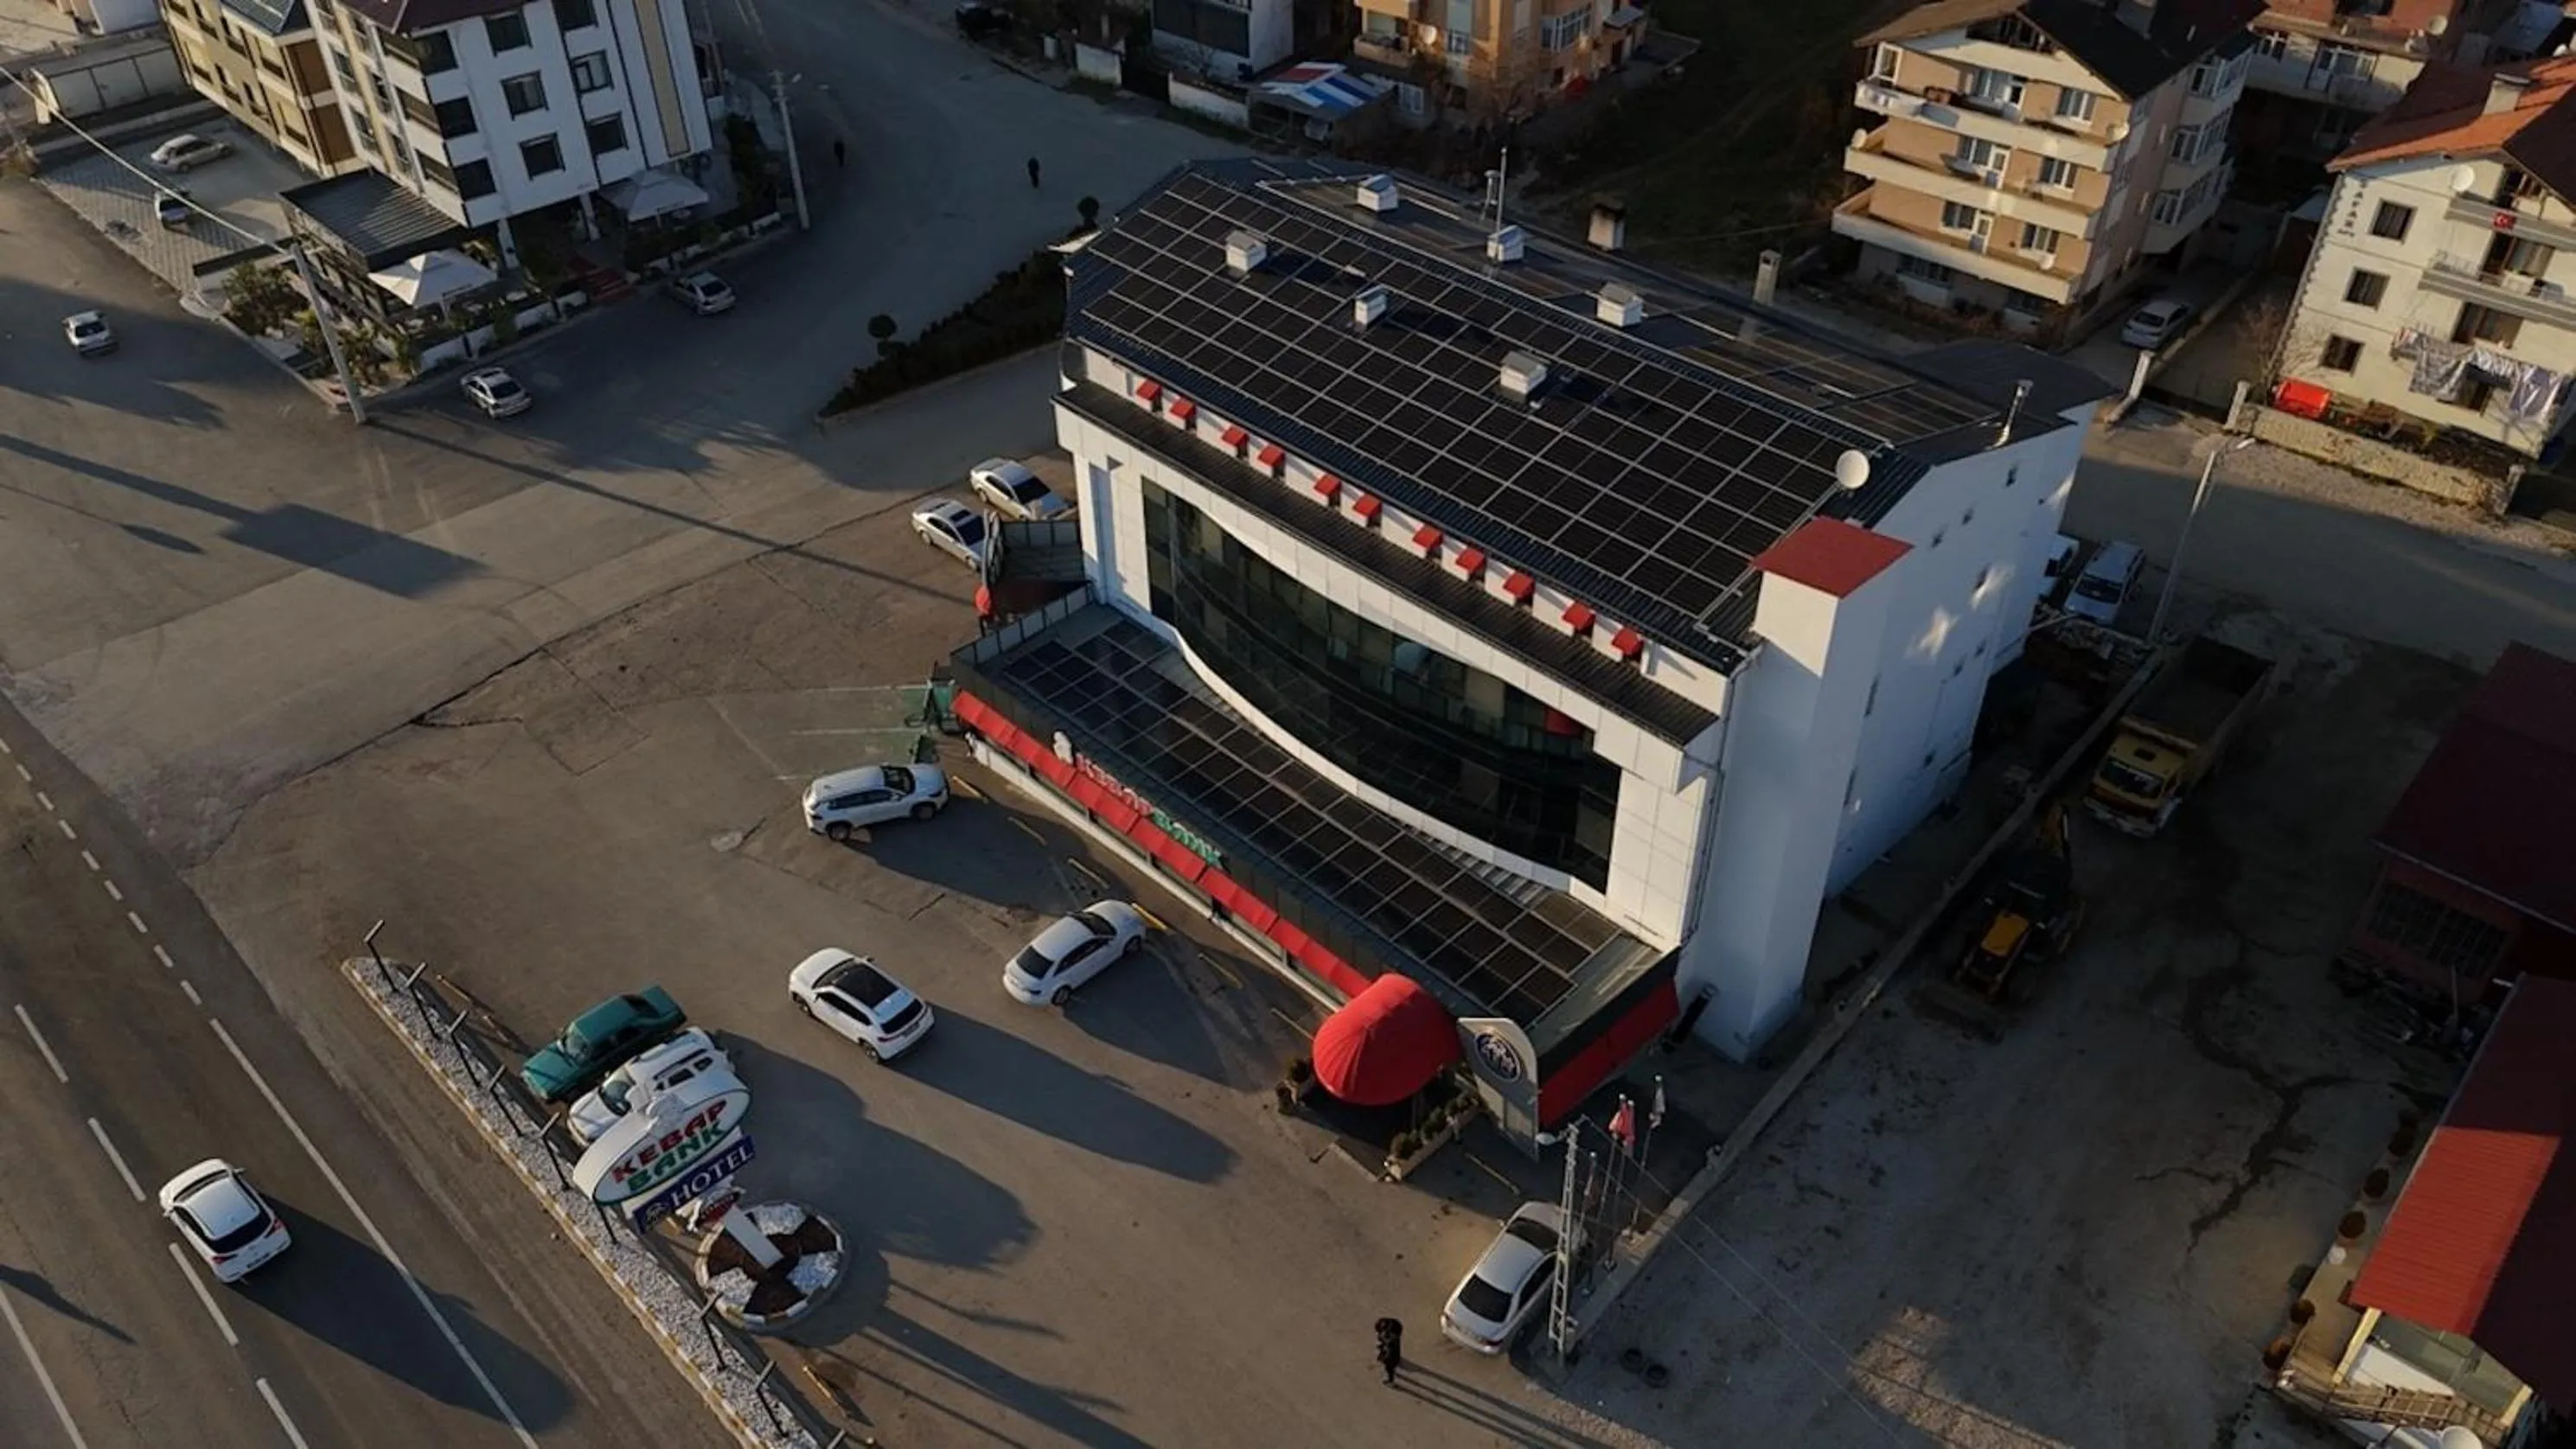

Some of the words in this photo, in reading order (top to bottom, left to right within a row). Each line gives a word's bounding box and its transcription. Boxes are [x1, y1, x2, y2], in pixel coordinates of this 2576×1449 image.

[611, 1100, 727, 1183] KEBAP
[628, 1120, 727, 1191] BANK
[671, 1146, 753, 1207] HOTEL
